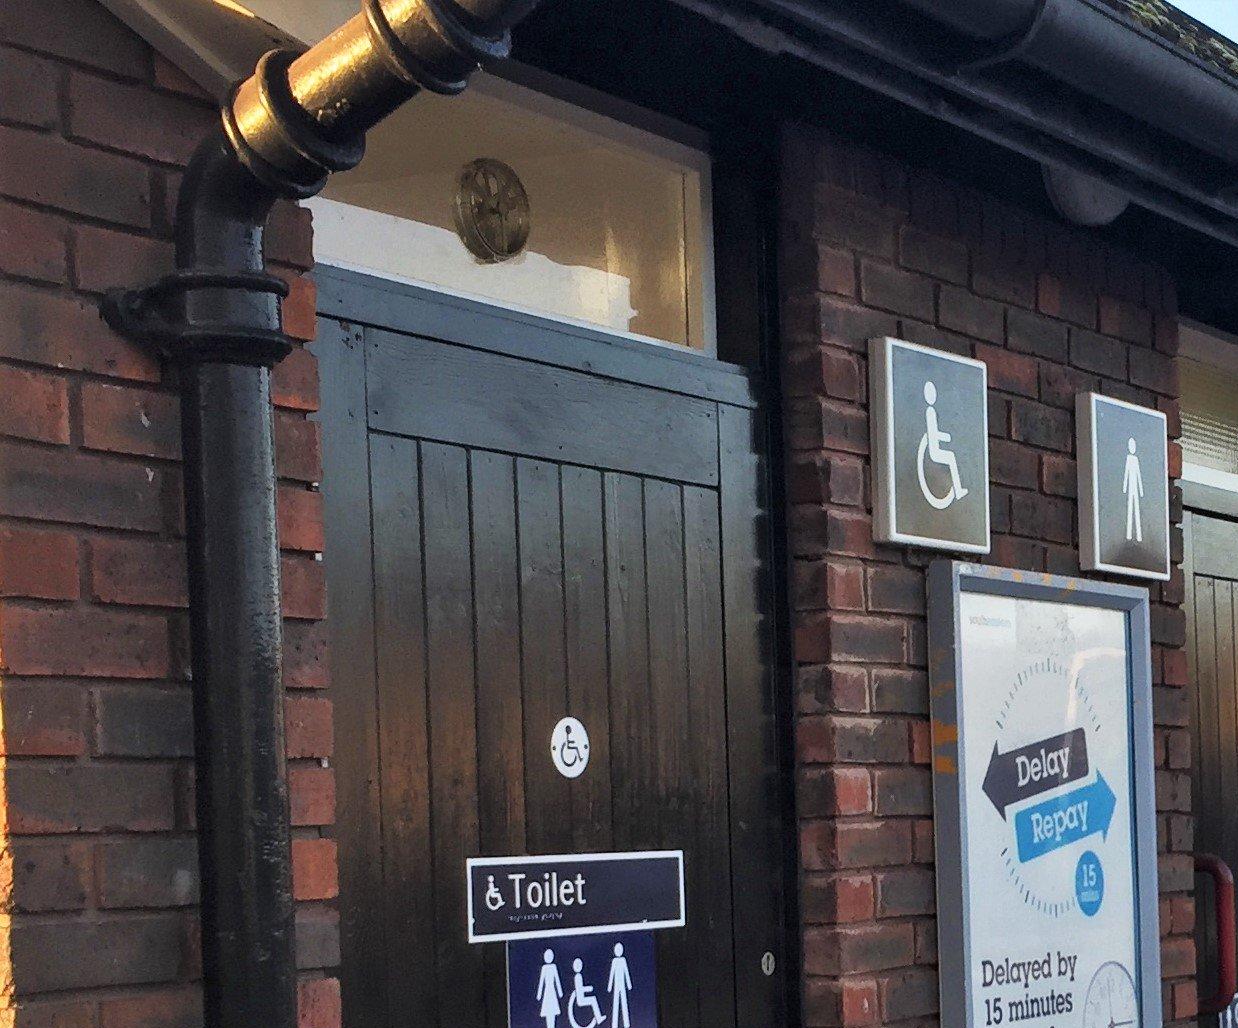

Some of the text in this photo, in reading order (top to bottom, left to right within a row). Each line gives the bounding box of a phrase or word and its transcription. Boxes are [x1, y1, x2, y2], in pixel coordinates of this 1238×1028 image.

[1015, 746, 1070, 788] Delay
[1030, 800, 1089, 844] Repay
[507, 871, 587, 909] Toilet
[1082, 863, 1097, 887] 15
[981, 950, 1078, 989] Delayed by
[984, 989, 1074, 1026] 15 minutes
